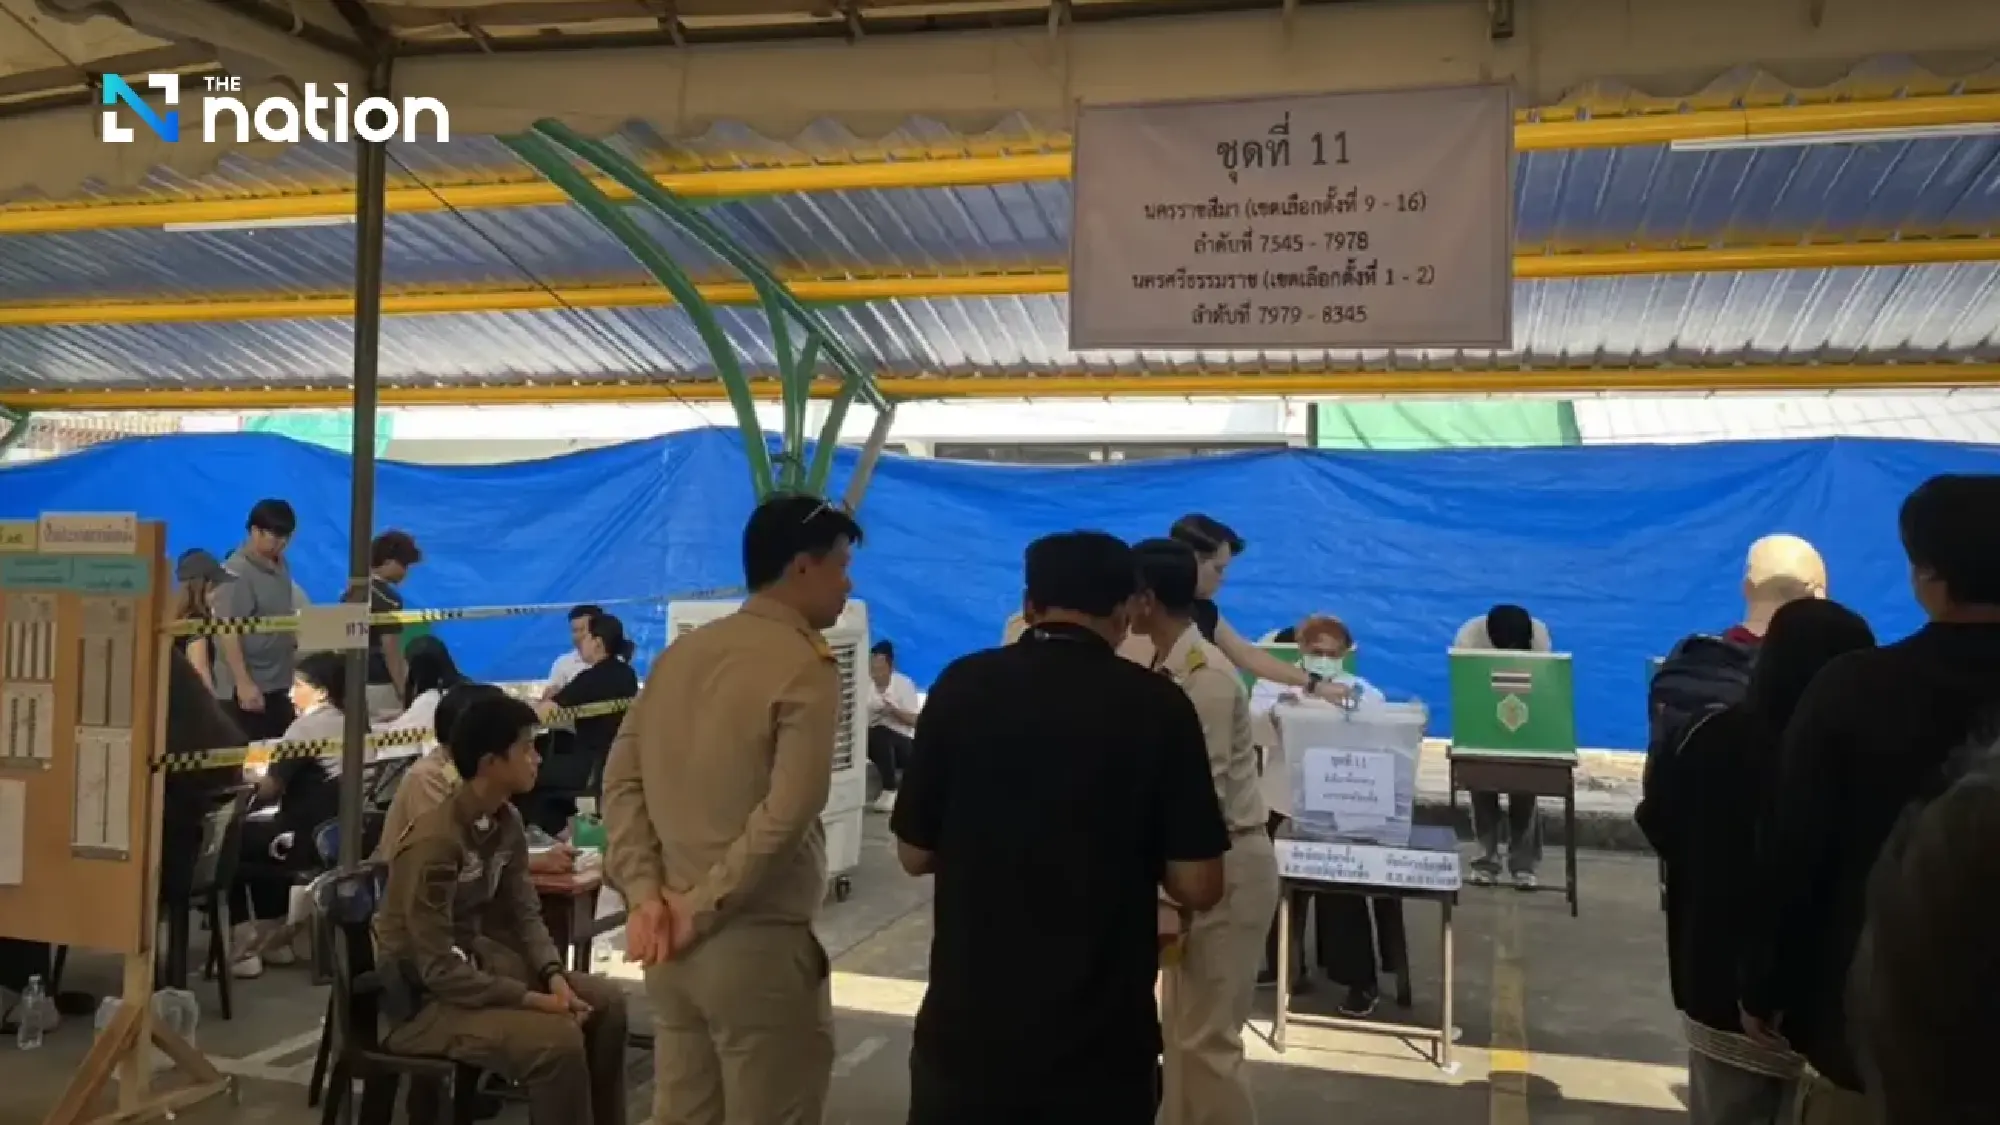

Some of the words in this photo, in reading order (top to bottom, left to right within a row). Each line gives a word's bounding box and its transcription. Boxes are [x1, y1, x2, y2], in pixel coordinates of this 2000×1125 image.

[1216, 112, 1291, 183] ชุดที่
[1310, 131, 1351, 166] 11
[1144, 196, 1239, 220] นครราชสีมา
[1364, 194, 1376, 214] 9
[1396, 190, 1427, 214] 16)
[1194, 226, 1253, 254] ลำดับที่
[1259, 234, 1304, 254] 7545
[1324, 231, 1370, 251] 7978
[1131, 266, 1258, 290] นครศรีธรรมราช
[1385, 267, 1395, 285] 1
[1415, 265, 1436, 285] 2)
[1191, 298, 1251, 326] ลำดับที่
[1258, 305, 1303, 324] 7979
[1322, 304, 1368, 323] 8345
